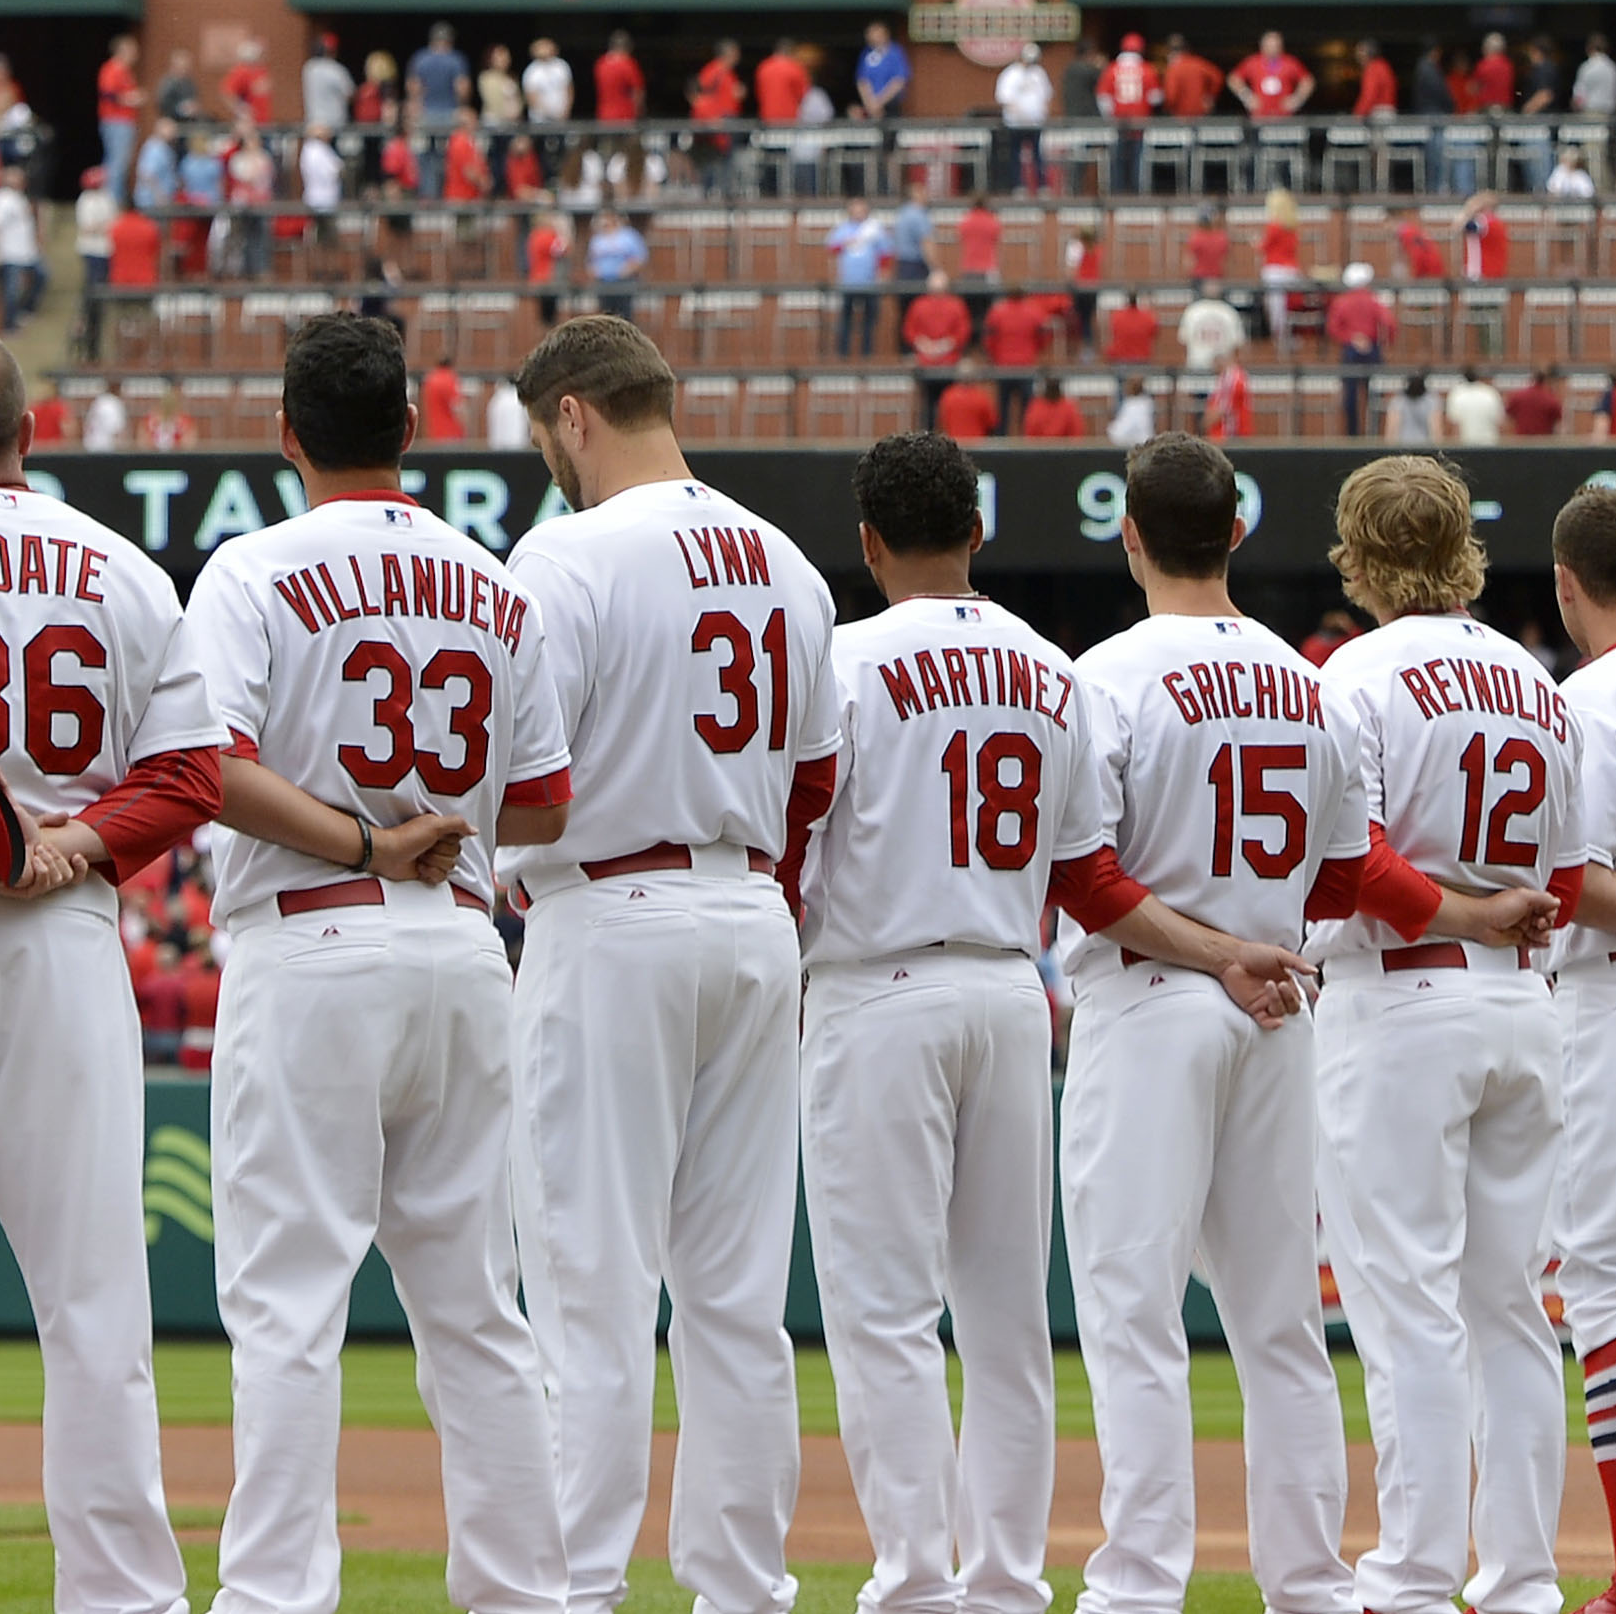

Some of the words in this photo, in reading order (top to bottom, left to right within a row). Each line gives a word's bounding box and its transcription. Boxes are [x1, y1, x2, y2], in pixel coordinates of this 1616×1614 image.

[275, 553, 527, 657] VILLANUEVA
[673, 527, 771, 589] LYNN
[338, 640, 493, 797] 33
[691, 608, 789, 754] 31
[878, 647, 1072, 731] MARTINEZ
[1162, 661, 1326, 731] GRICHUK
[1400, 658, 1567, 744] REYNOLDS
[941, 730, 1042, 871] 18
[1208, 743, 1307, 879] 15
[1459, 732, 1546, 867] 12
